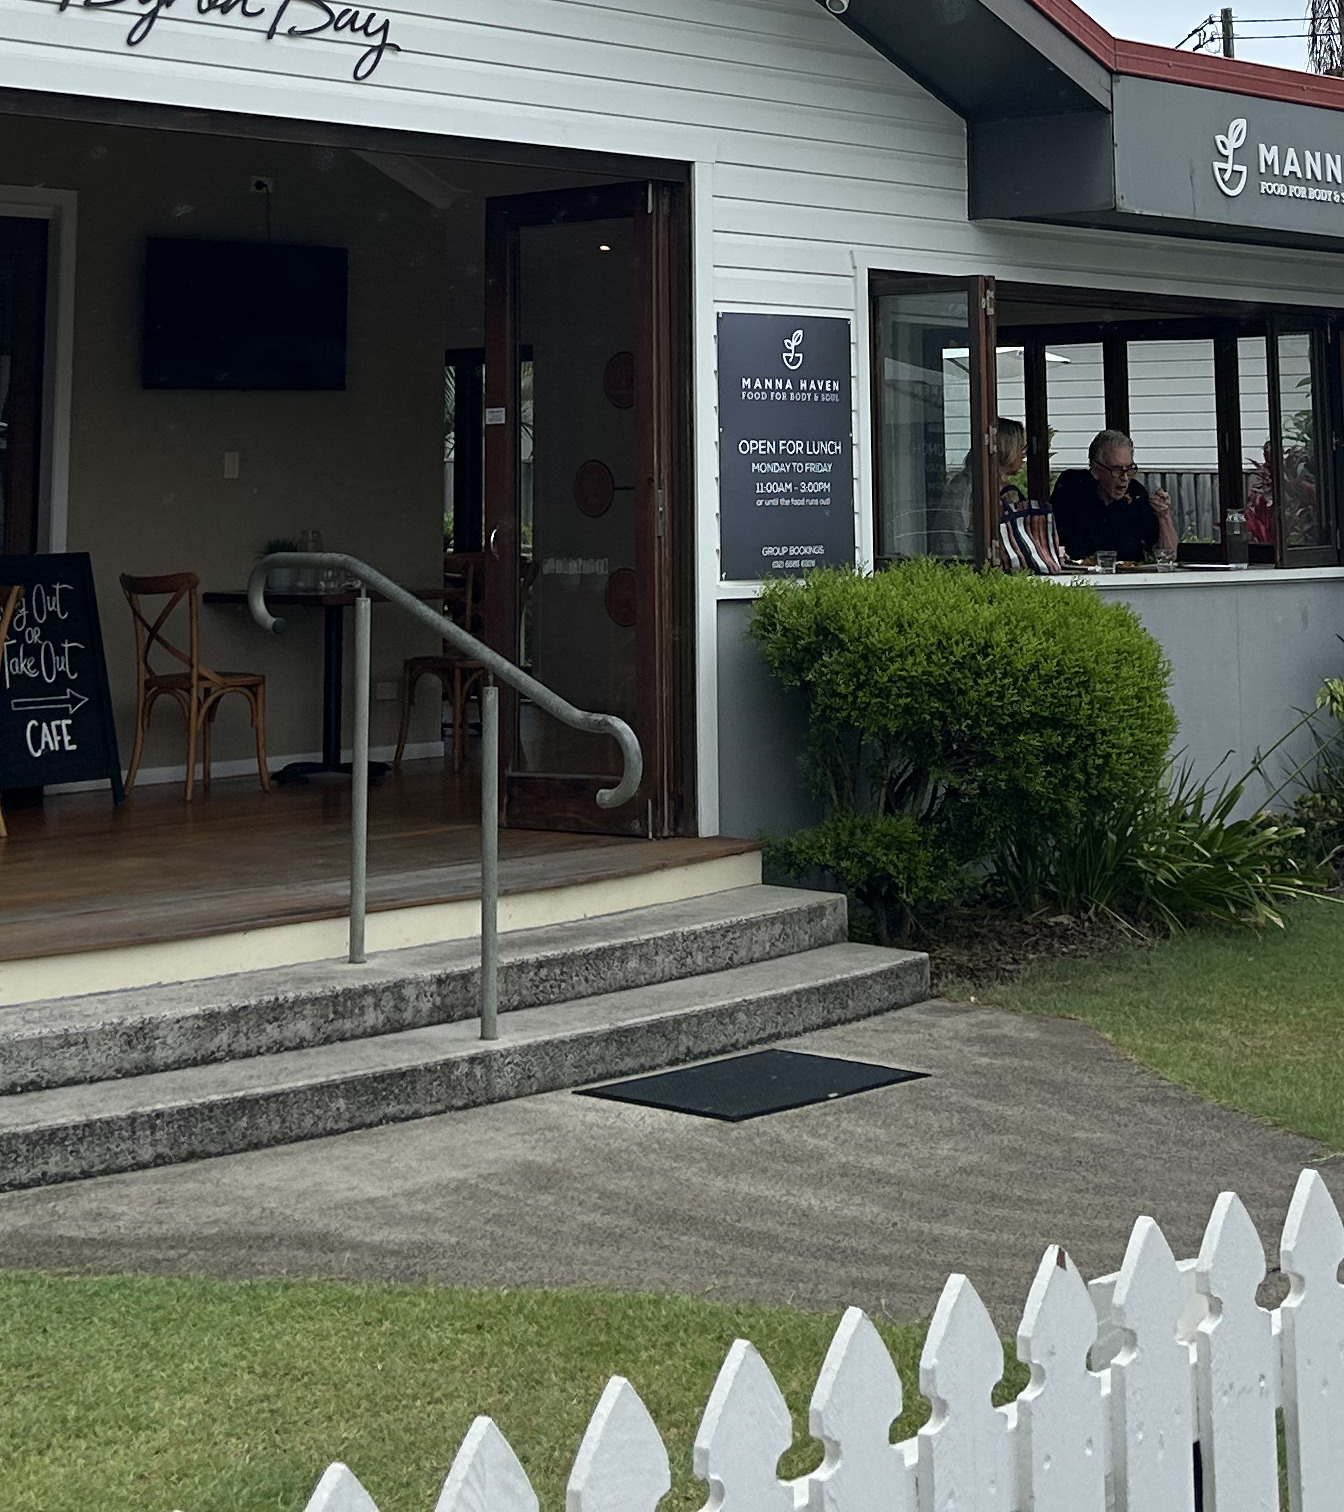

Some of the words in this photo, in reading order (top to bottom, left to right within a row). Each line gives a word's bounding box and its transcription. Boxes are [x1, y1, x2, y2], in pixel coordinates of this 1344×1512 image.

[1259, 181, 1286, 196] FOOD
[1287, 185, 1308, 199] FOR
[1308, 187, 1333, 203] BODY
[1333, 190, 1341, 205] &
[741, 377, 793, 390] MANNA
[799, 379, 840, 392] HAVEN
[741, 391, 767, 401] FOOD
[770, 392, 788, 401] FOR
[790, 392, 812, 402] BODY
[821, 394, 840, 403] SOUL
[738, 439, 776, 455] OPEN
[779, 440, 804, 456] FOR
[806, 440, 842, 456] LUNCH
[751, 462, 791, 474] MONDAY
[792, 462, 804, 474] TO
[805, 462, 833, 474] FRIDAY
[755, 482, 793, 494] 11:00AM
[800, 482, 831, 494] 3:00PM
[765, 497, 779, 506] until
[780, 497, 791, 506] the
[791, 498, 805, 506] food
[761, 546, 788, 557] GROUP
[32, 582, 74, 623] Out
[25, 626, 42, 645] OR
[40, 639, 86, 684] Out
[26, 719, 77, 758] CAFE
